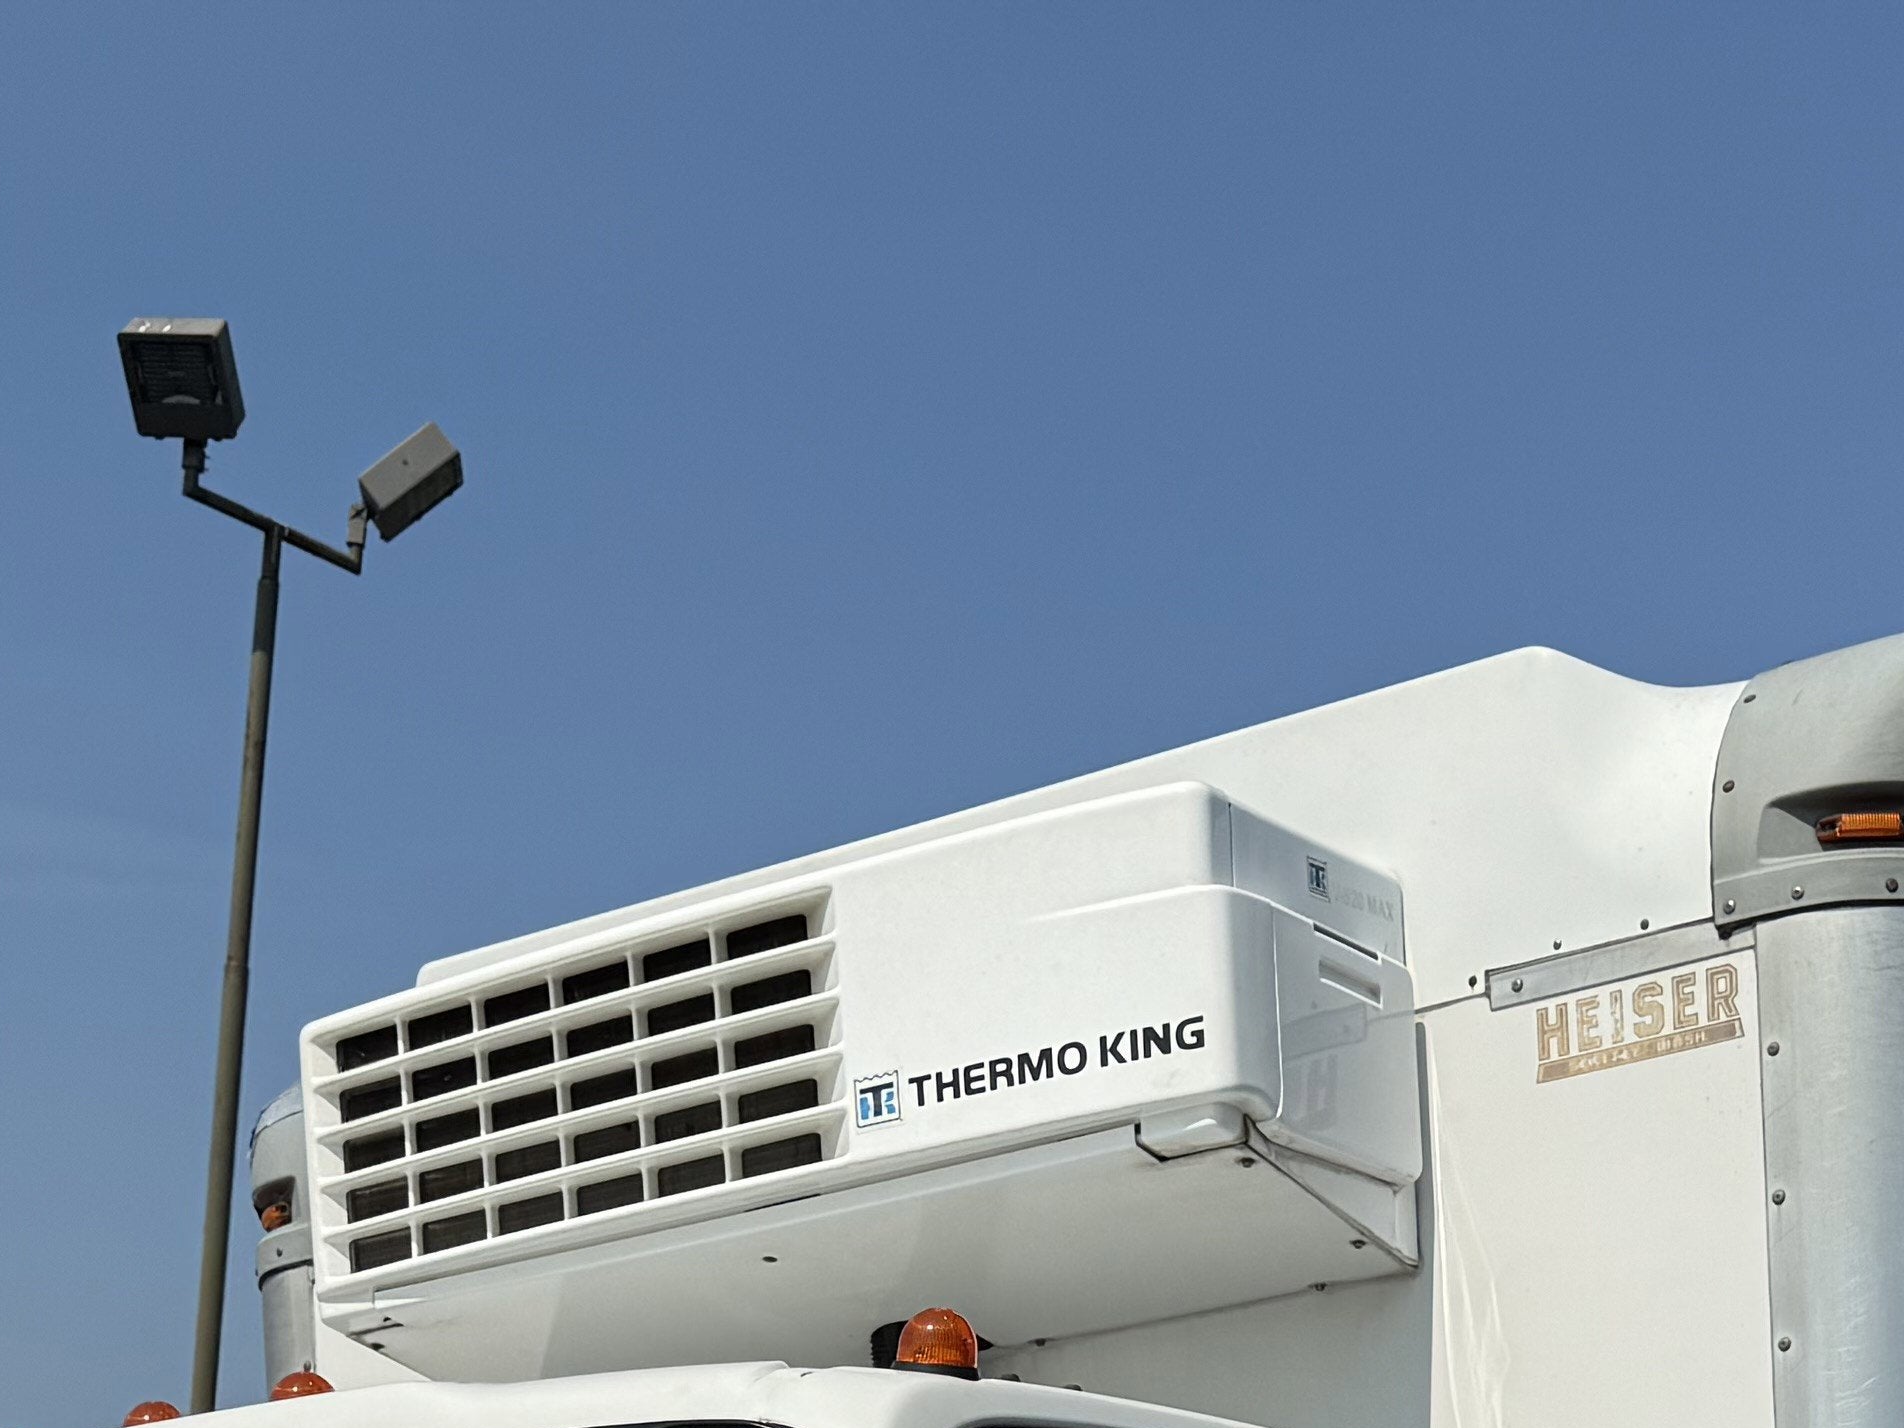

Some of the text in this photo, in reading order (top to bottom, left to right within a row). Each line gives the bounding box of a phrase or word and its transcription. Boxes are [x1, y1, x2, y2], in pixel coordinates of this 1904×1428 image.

[1536, 963, 1739, 1061] HEISER
[908, 1041, 1088, 1107] THERMO
[1099, 1015, 1206, 1068] KING
